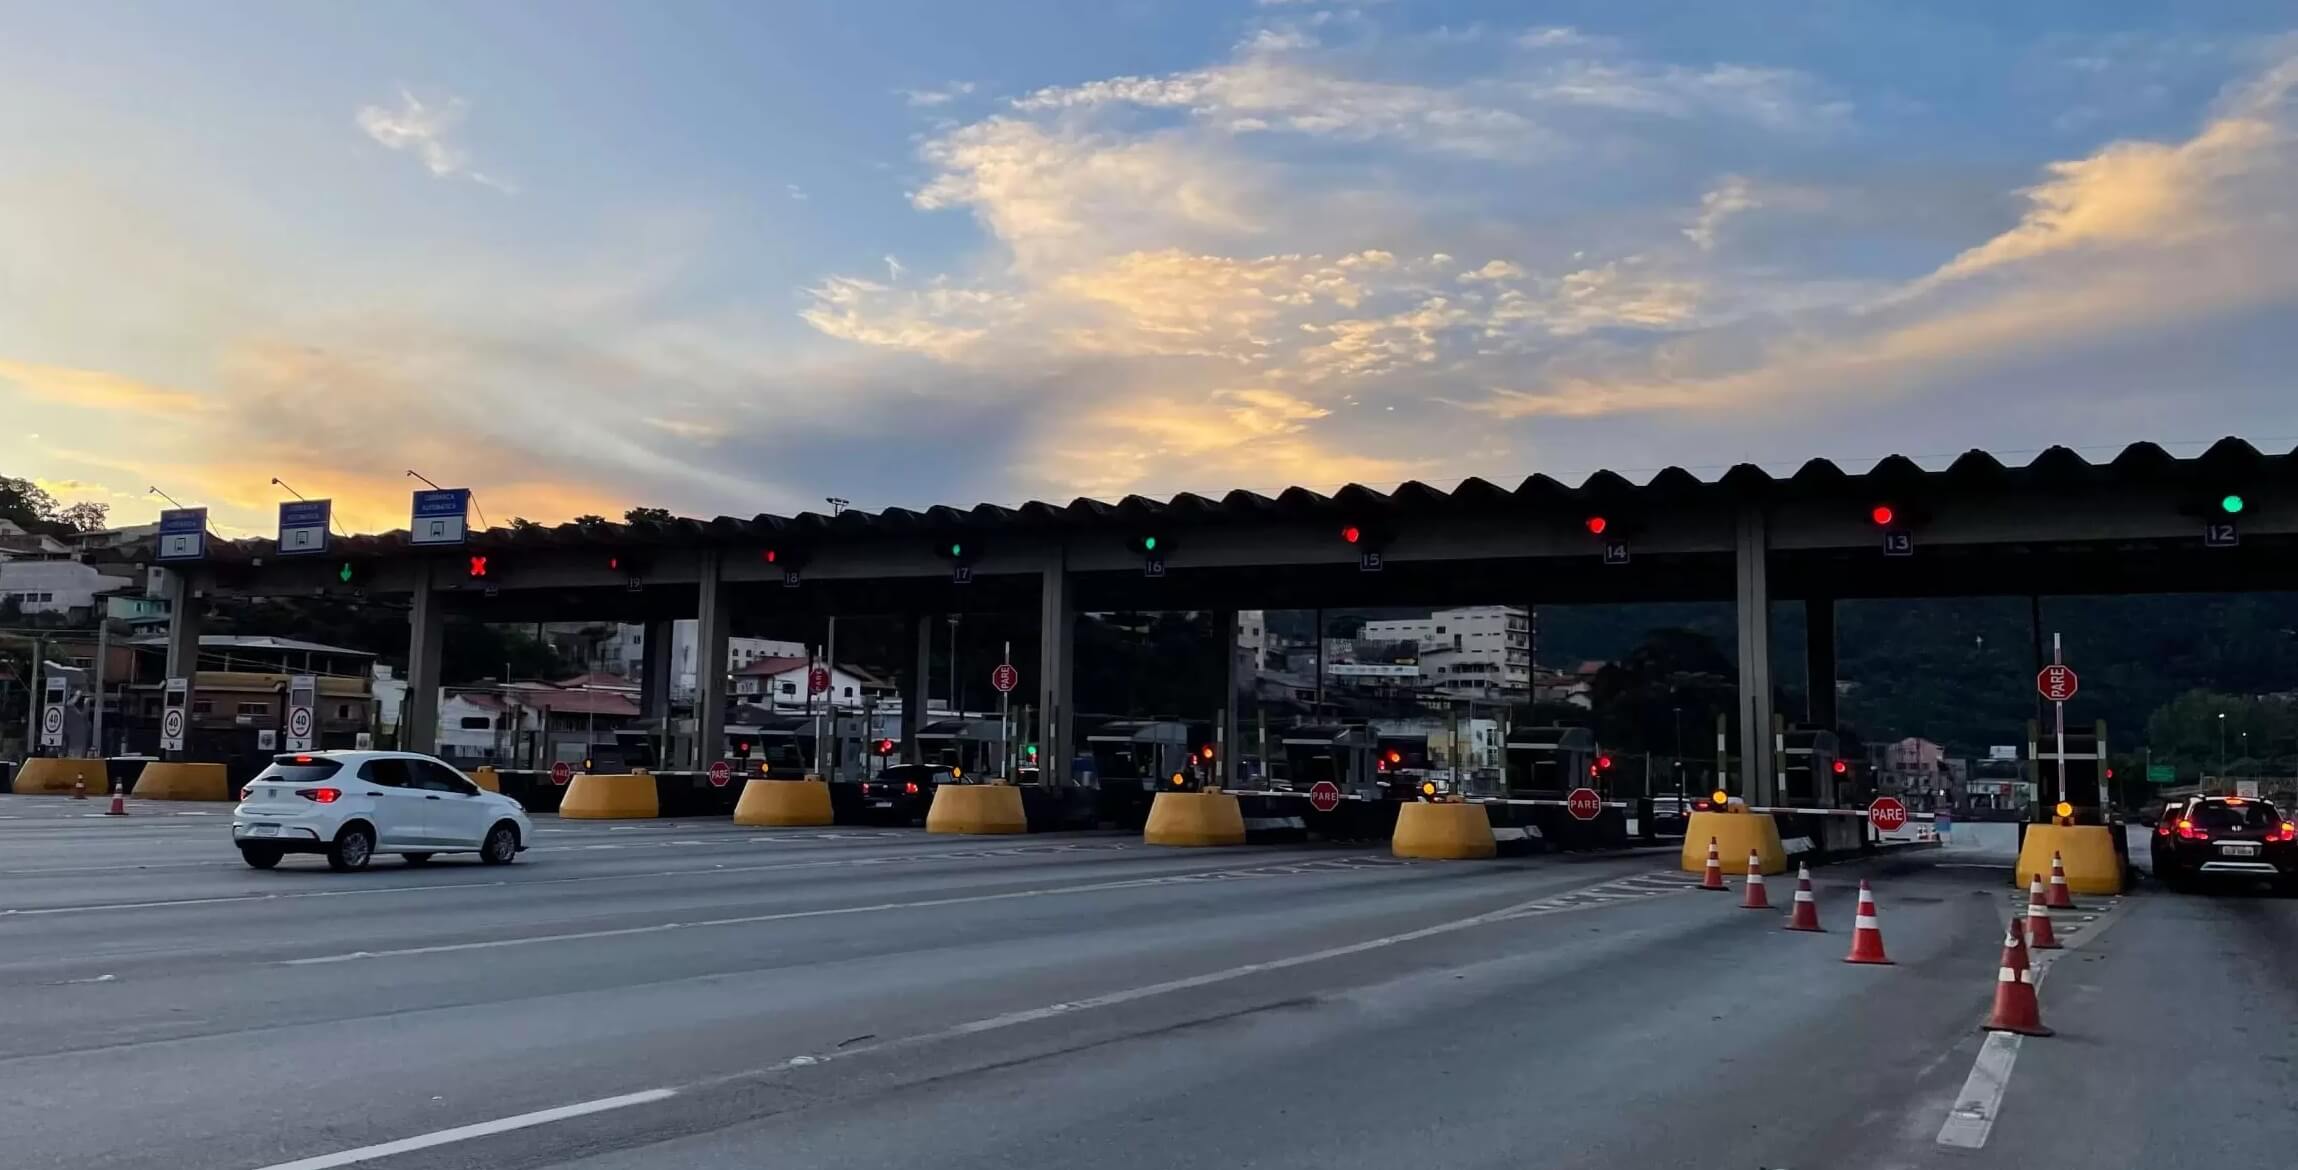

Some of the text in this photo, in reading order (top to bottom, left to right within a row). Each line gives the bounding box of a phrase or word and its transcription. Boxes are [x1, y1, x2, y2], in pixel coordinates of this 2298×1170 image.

[2211, 524, 2235, 541] 12
[1887, 535, 1908, 550] 13
[1606, 545, 1626, 559] 14
[1363, 553, 1380, 567] 15
[956, 567, 969, 579] 17
[1147, 561, 1162, 573] 16
[629, 577, 641, 588] 19
[785, 572, 798, 584] 18
[1000, 667, 1010, 689] PARE
[2050, 668, 2066, 698] PARE
[48, 713, 59, 724] 40
[168, 716, 179, 727] 40
[295, 714, 307, 726] 40
[553, 769, 568, 778] PARE
[711, 769, 729, 779] PARE
[1312, 793, 1337, 801] PARE
[1570, 800, 1598, 809] PARE
[1872, 808, 1903, 821] PARE
